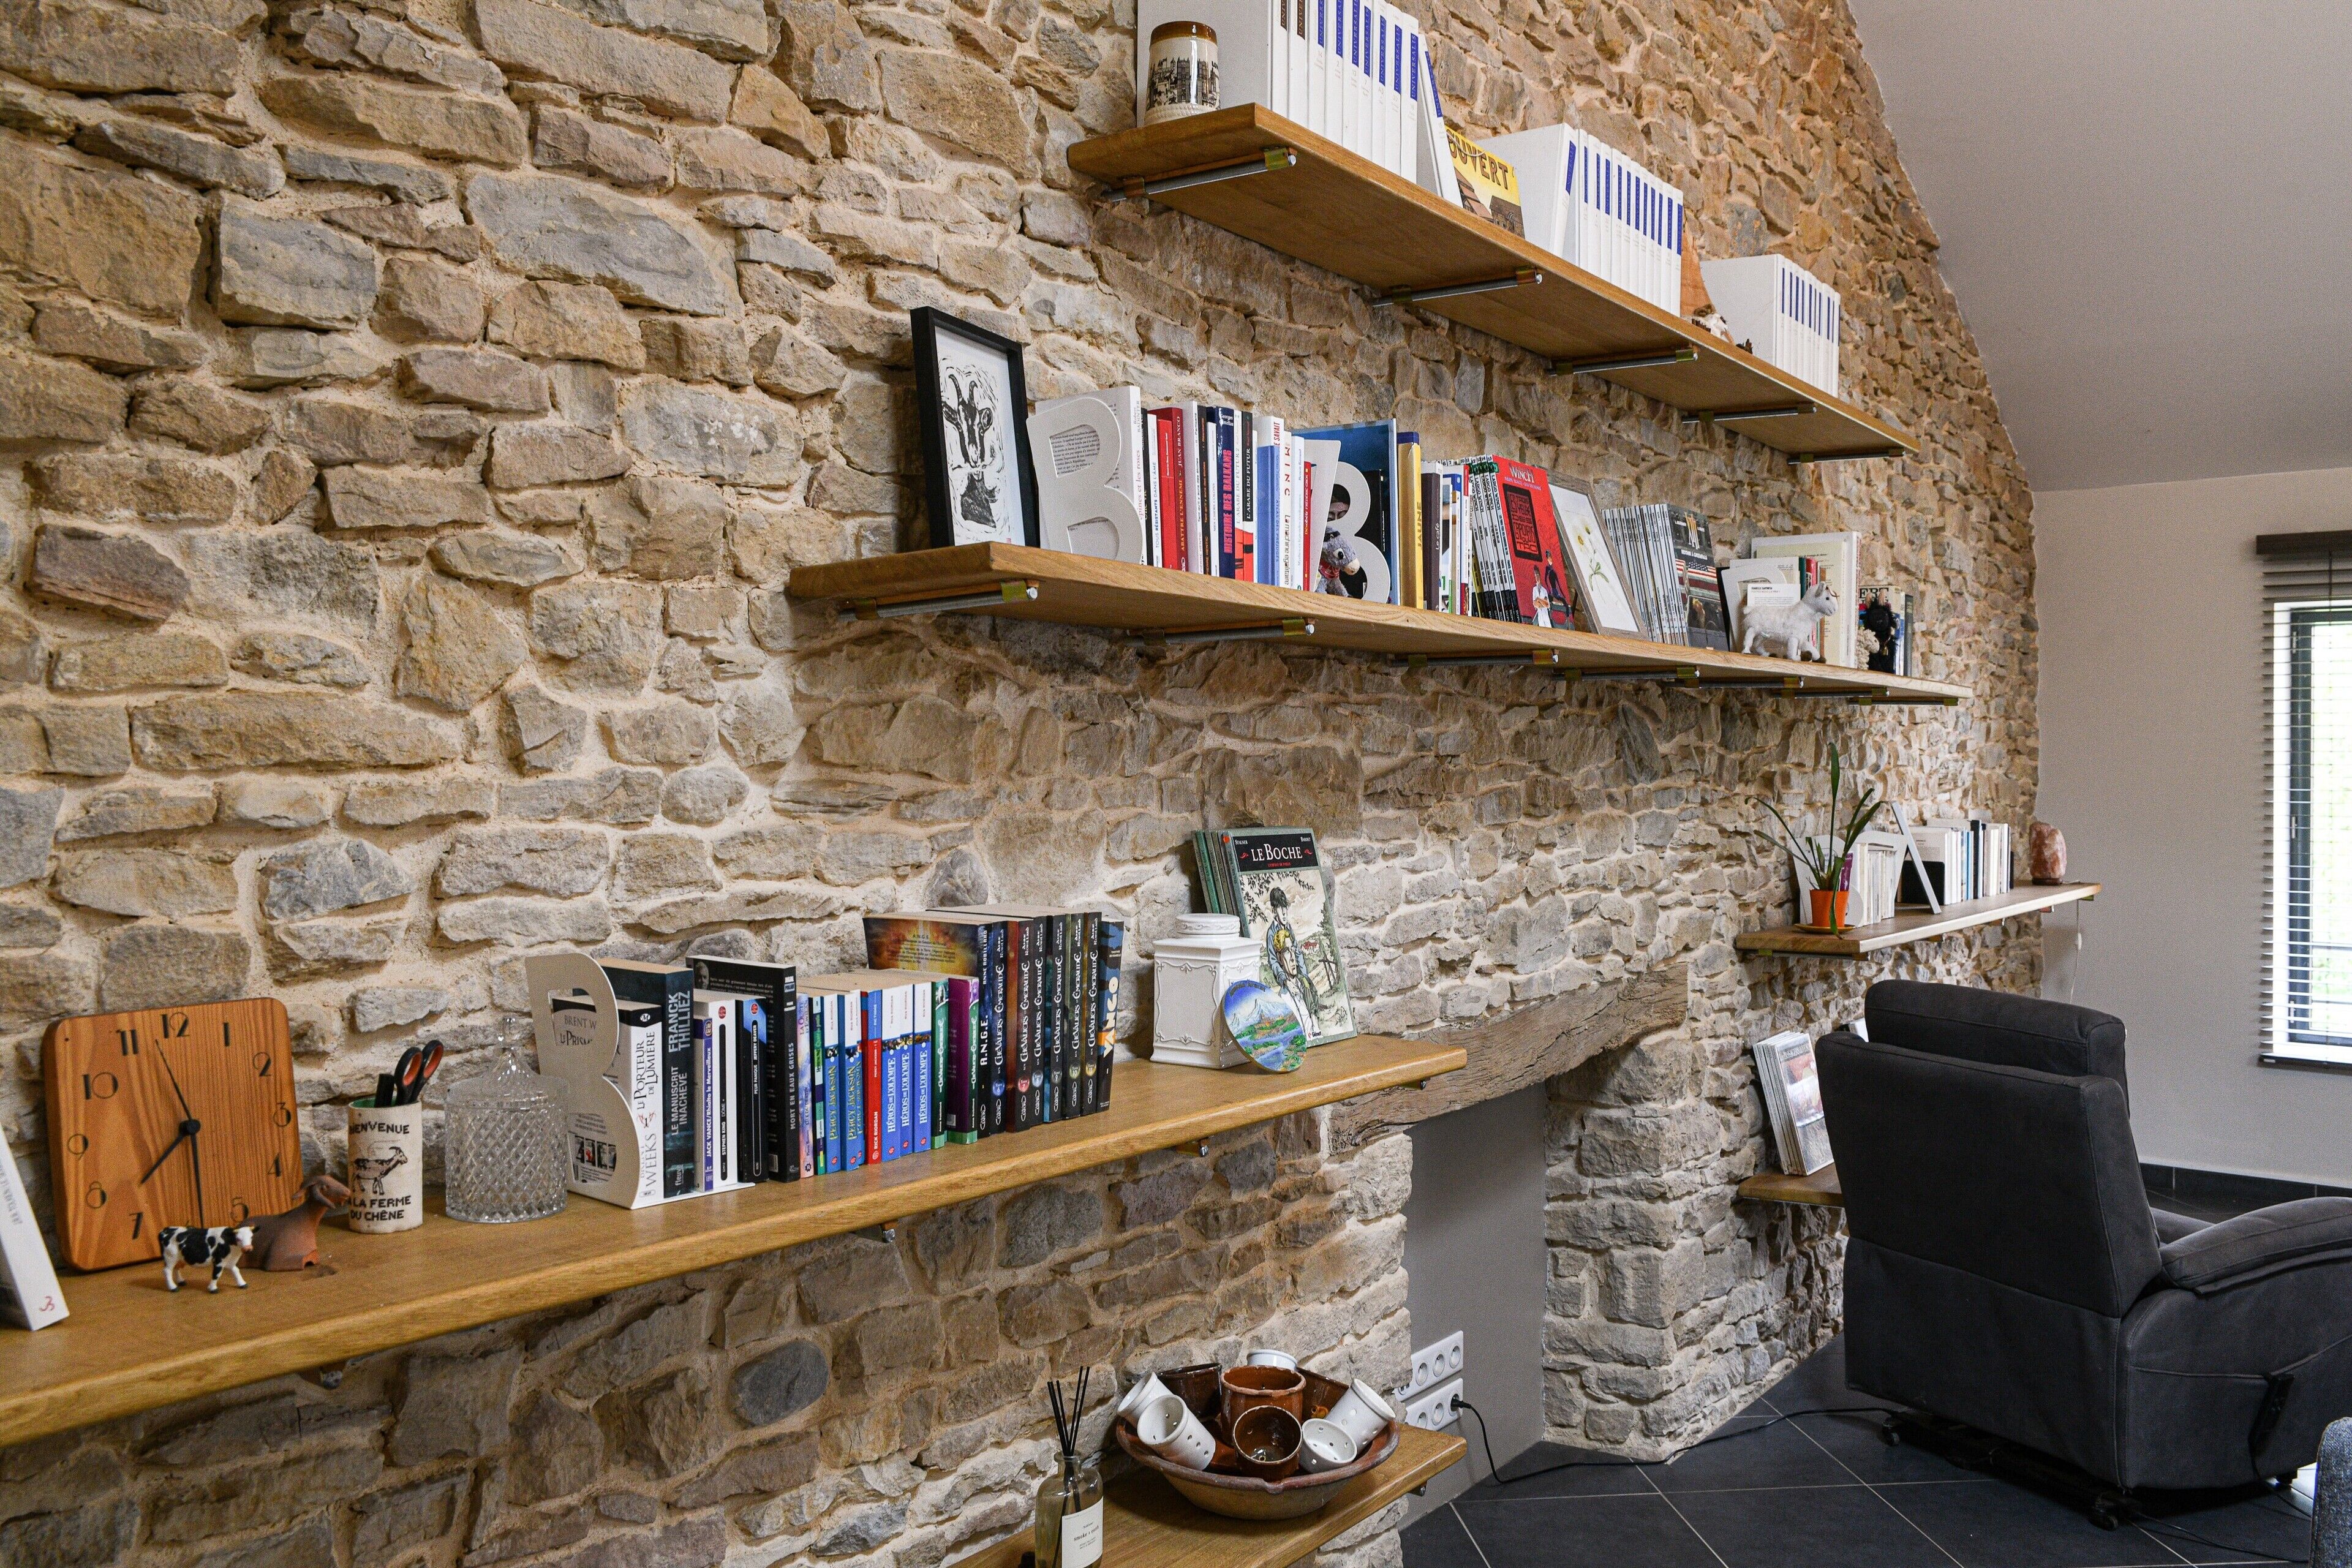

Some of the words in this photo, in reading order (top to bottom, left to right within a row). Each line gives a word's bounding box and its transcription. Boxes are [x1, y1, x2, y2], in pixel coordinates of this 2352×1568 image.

[1446, 129, 1508, 190] OUVERT
[1223, 450, 1231, 491] BALKANS
[1246, 476, 1250, 487] DU
[1509, 466, 1535, 483] WINCH
[1235, 481, 1240, 491] DU
[1223, 494, 1232, 511] DES
[1224, 513, 1232, 553] HISTOIRE
[1435, 541, 1439, 550] Le
[1251, 848, 1265, 861] LE
[1264, 843, 1303, 860] BOCHE
[161, 1012, 190, 1039] 12
[565, 1015, 587, 1028] BRENT
[668, 993, 678, 1052] FRANCK
[678, 990, 690, 1050] THILLIEZ
[1103, 976, 1118, 1058] VANGO
[121, 1029, 139, 1056] 11
[223, 1022, 230, 1047] 1
[253, 1052, 272, 1077] 2
[633, 1041, 647, 1099] PORTEUR
[644, 1031, 658, 1084] LUMIÈRE
[82, 1072, 119, 1100] 10
[648, 1086, 654, 1095] DE
[828, 1066, 837, 1107] JACKSON
[847, 1066, 856, 1107] JACKSON
[888, 1058, 896, 1096] L'OLYMPE
[790, 1095, 794, 1106] EN
[900, 1098, 910, 1126] HÉROS
[919, 1095, 928, 1123] HÉROS
[273, 1102, 292, 1127] 3
[828, 1109, 838, 1141] PERCY
[847, 1110, 857, 1140] PERCY
[886, 1103, 896, 1133] HÉROS
[671, 1124, 679, 1136] LE
[67, 1134, 89, 1161] 9
[645, 1133, 657, 1188] WEEKS
[268, 1153, 282, 1178] 4
[86, 1181, 107, 1208] 8
[353, 1199, 366, 1207] LA
[370, 1196, 411, 1208] FERME
[230, 1196, 249, 1223] 5
[351, 1210, 361, 1219] DU
[364, 1209, 404, 1221] CHÊNE
[129, 1212, 144, 1240] 7
